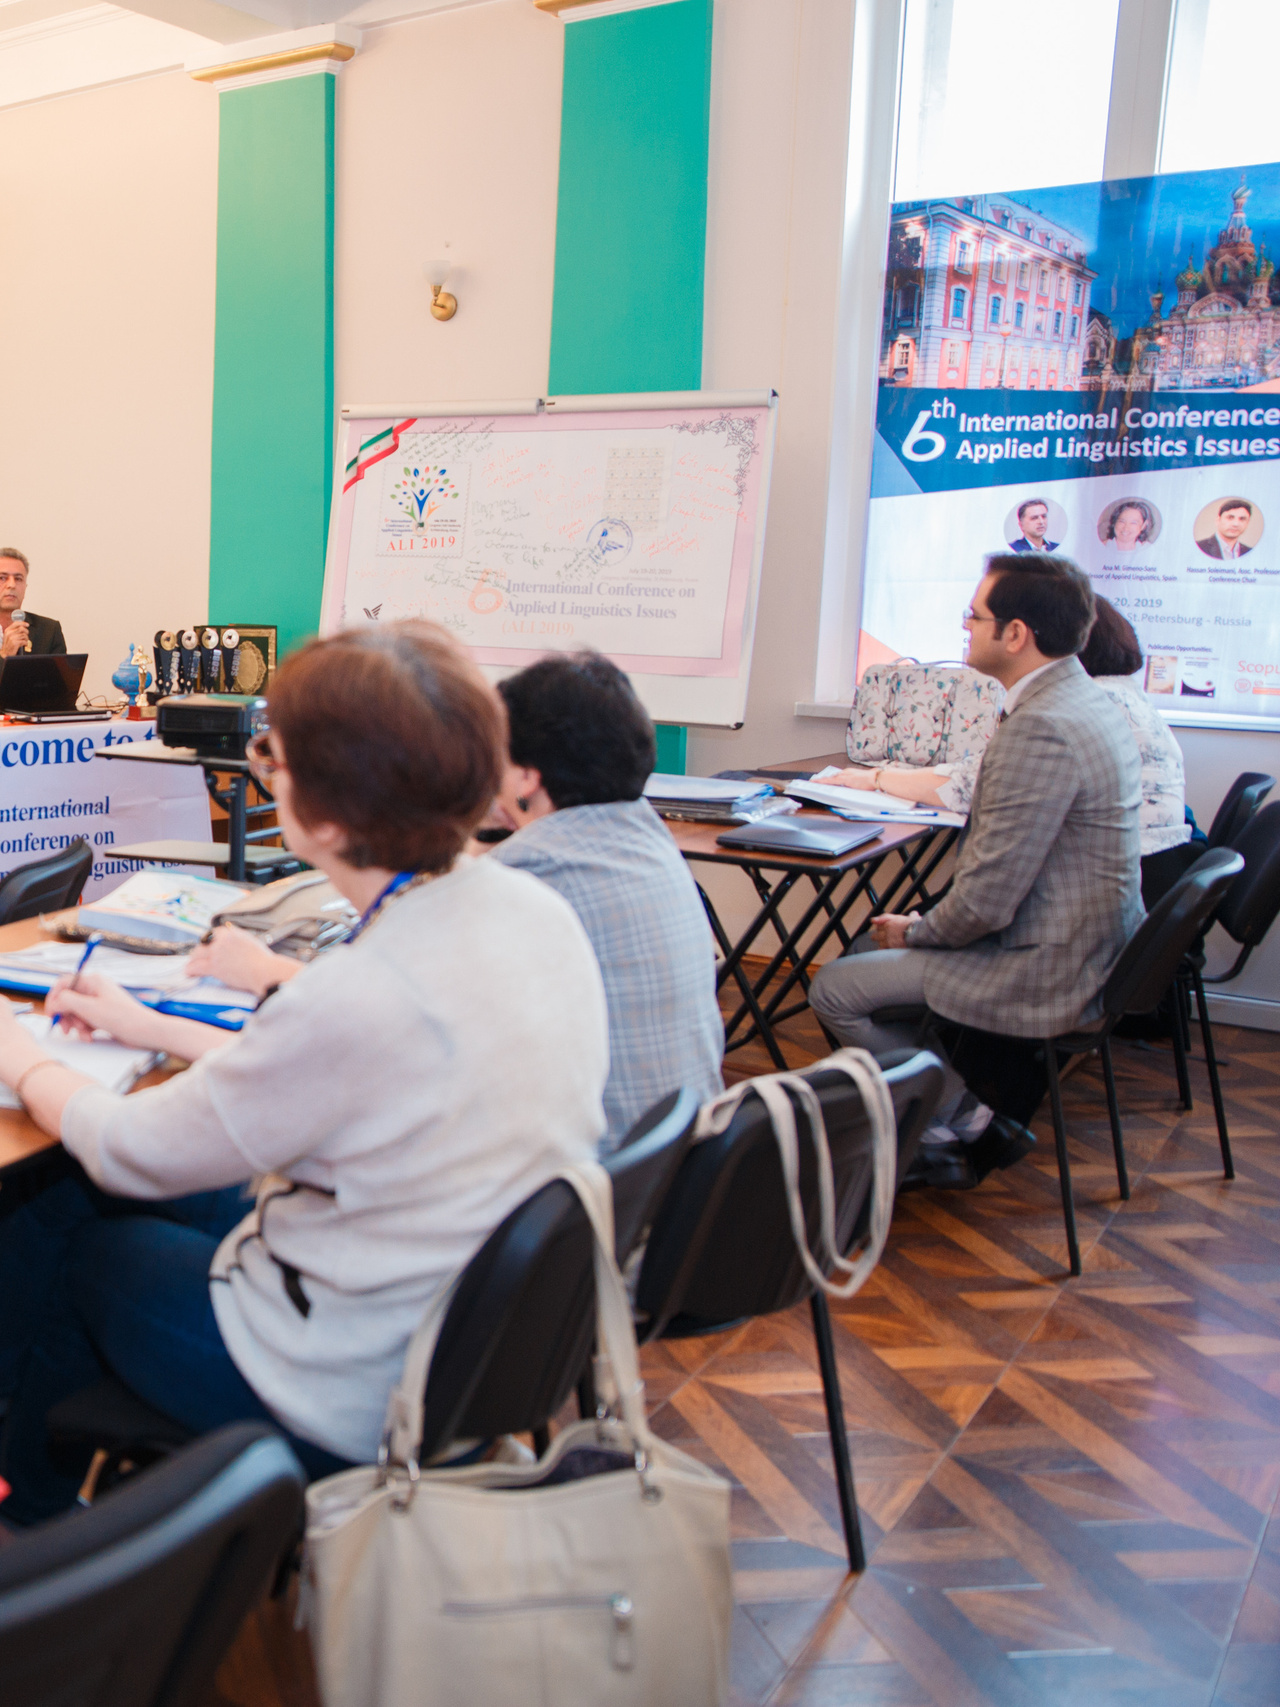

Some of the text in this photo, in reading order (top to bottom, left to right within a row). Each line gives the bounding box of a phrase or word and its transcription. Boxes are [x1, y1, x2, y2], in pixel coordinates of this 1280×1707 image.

[959, 404, 1280, 432] International Conference
[901, 396, 956, 462] 6th
[955, 434, 1280, 464] Applied Linguistics Issues
[386, 536, 456, 552] ALI 2019
[506, 579, 594, 596] International
[596, 580, 676, 598] Conference
[678, 586, 696, 599] on
[504, 600, 677, 620] Applied Linguistics Issues
[1134, 597, 1163, 608] 2019
[501, 620, 575, 637] (ALI 2019)
[1214, 616, 1252, 627] Russia
[94, 829, 115, 846] on
